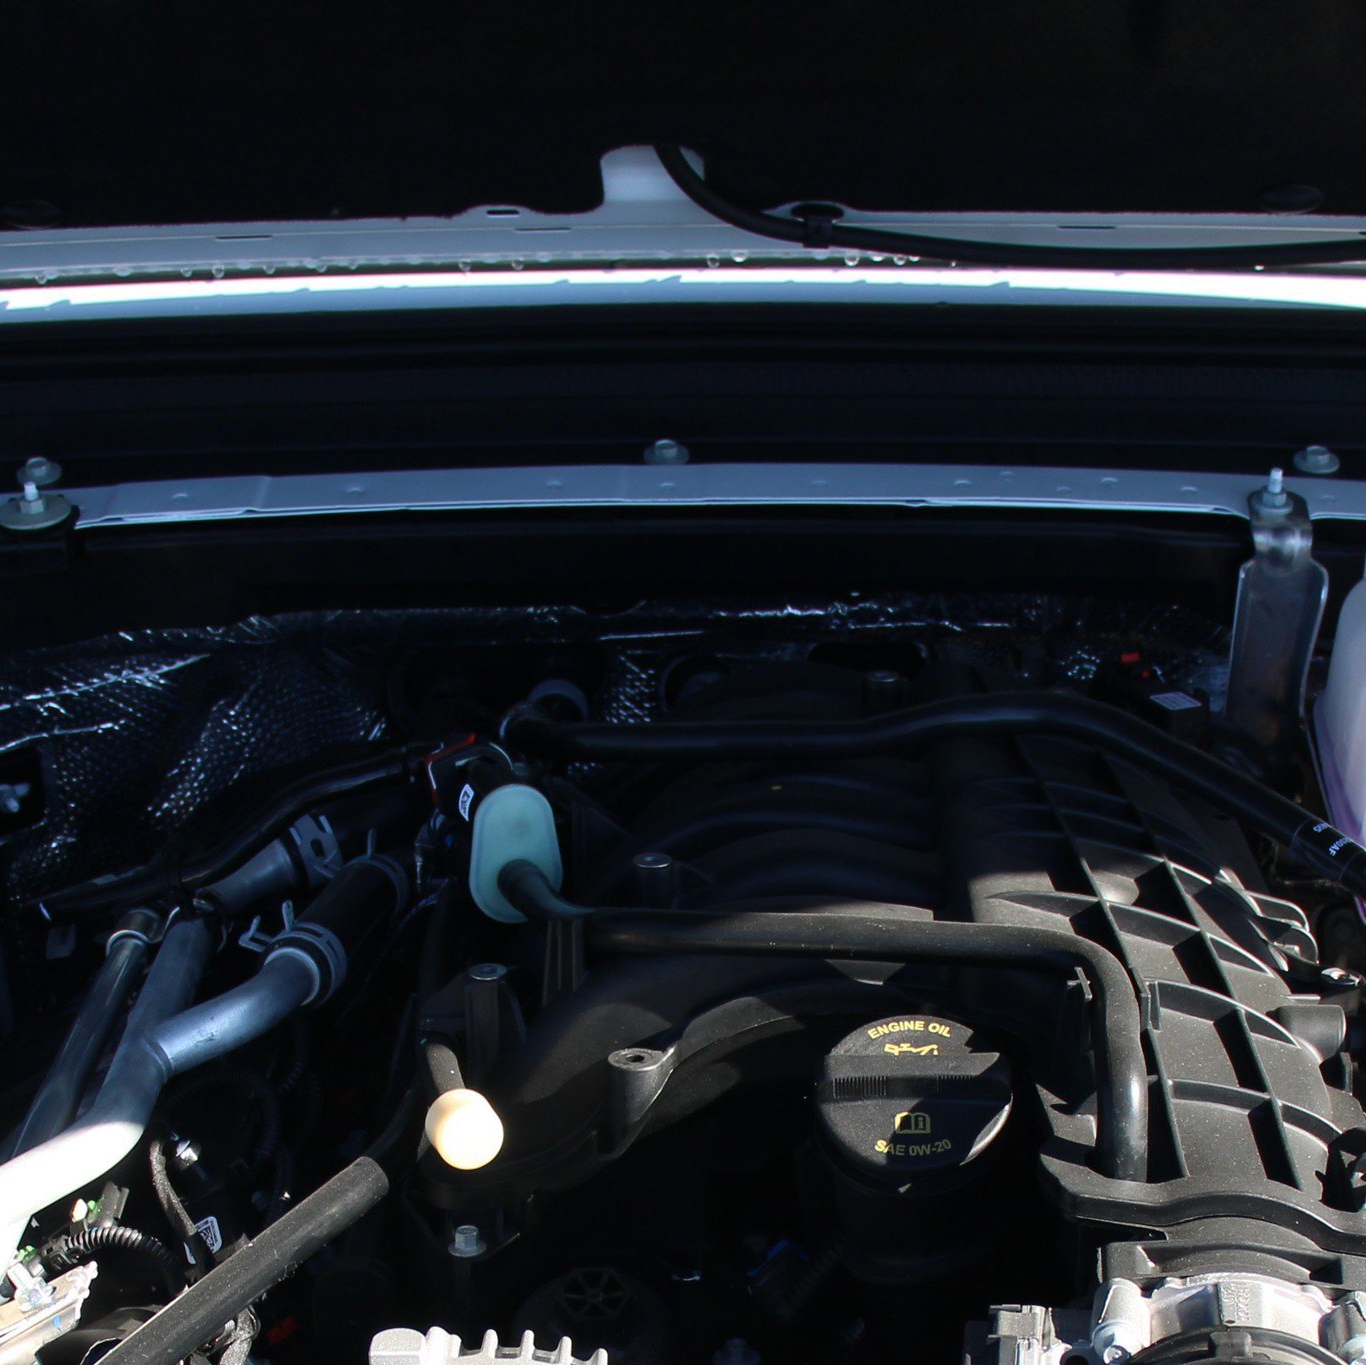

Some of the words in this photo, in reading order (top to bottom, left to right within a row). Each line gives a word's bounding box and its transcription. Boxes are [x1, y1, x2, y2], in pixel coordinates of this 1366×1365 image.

[867, 1020, 925, 1040] ENGINE
[927, 1022, 952, 1038] OIL
[874, 1139, 906, 1156] SAE
[908, 1138, 952, 1157] 0W-20
